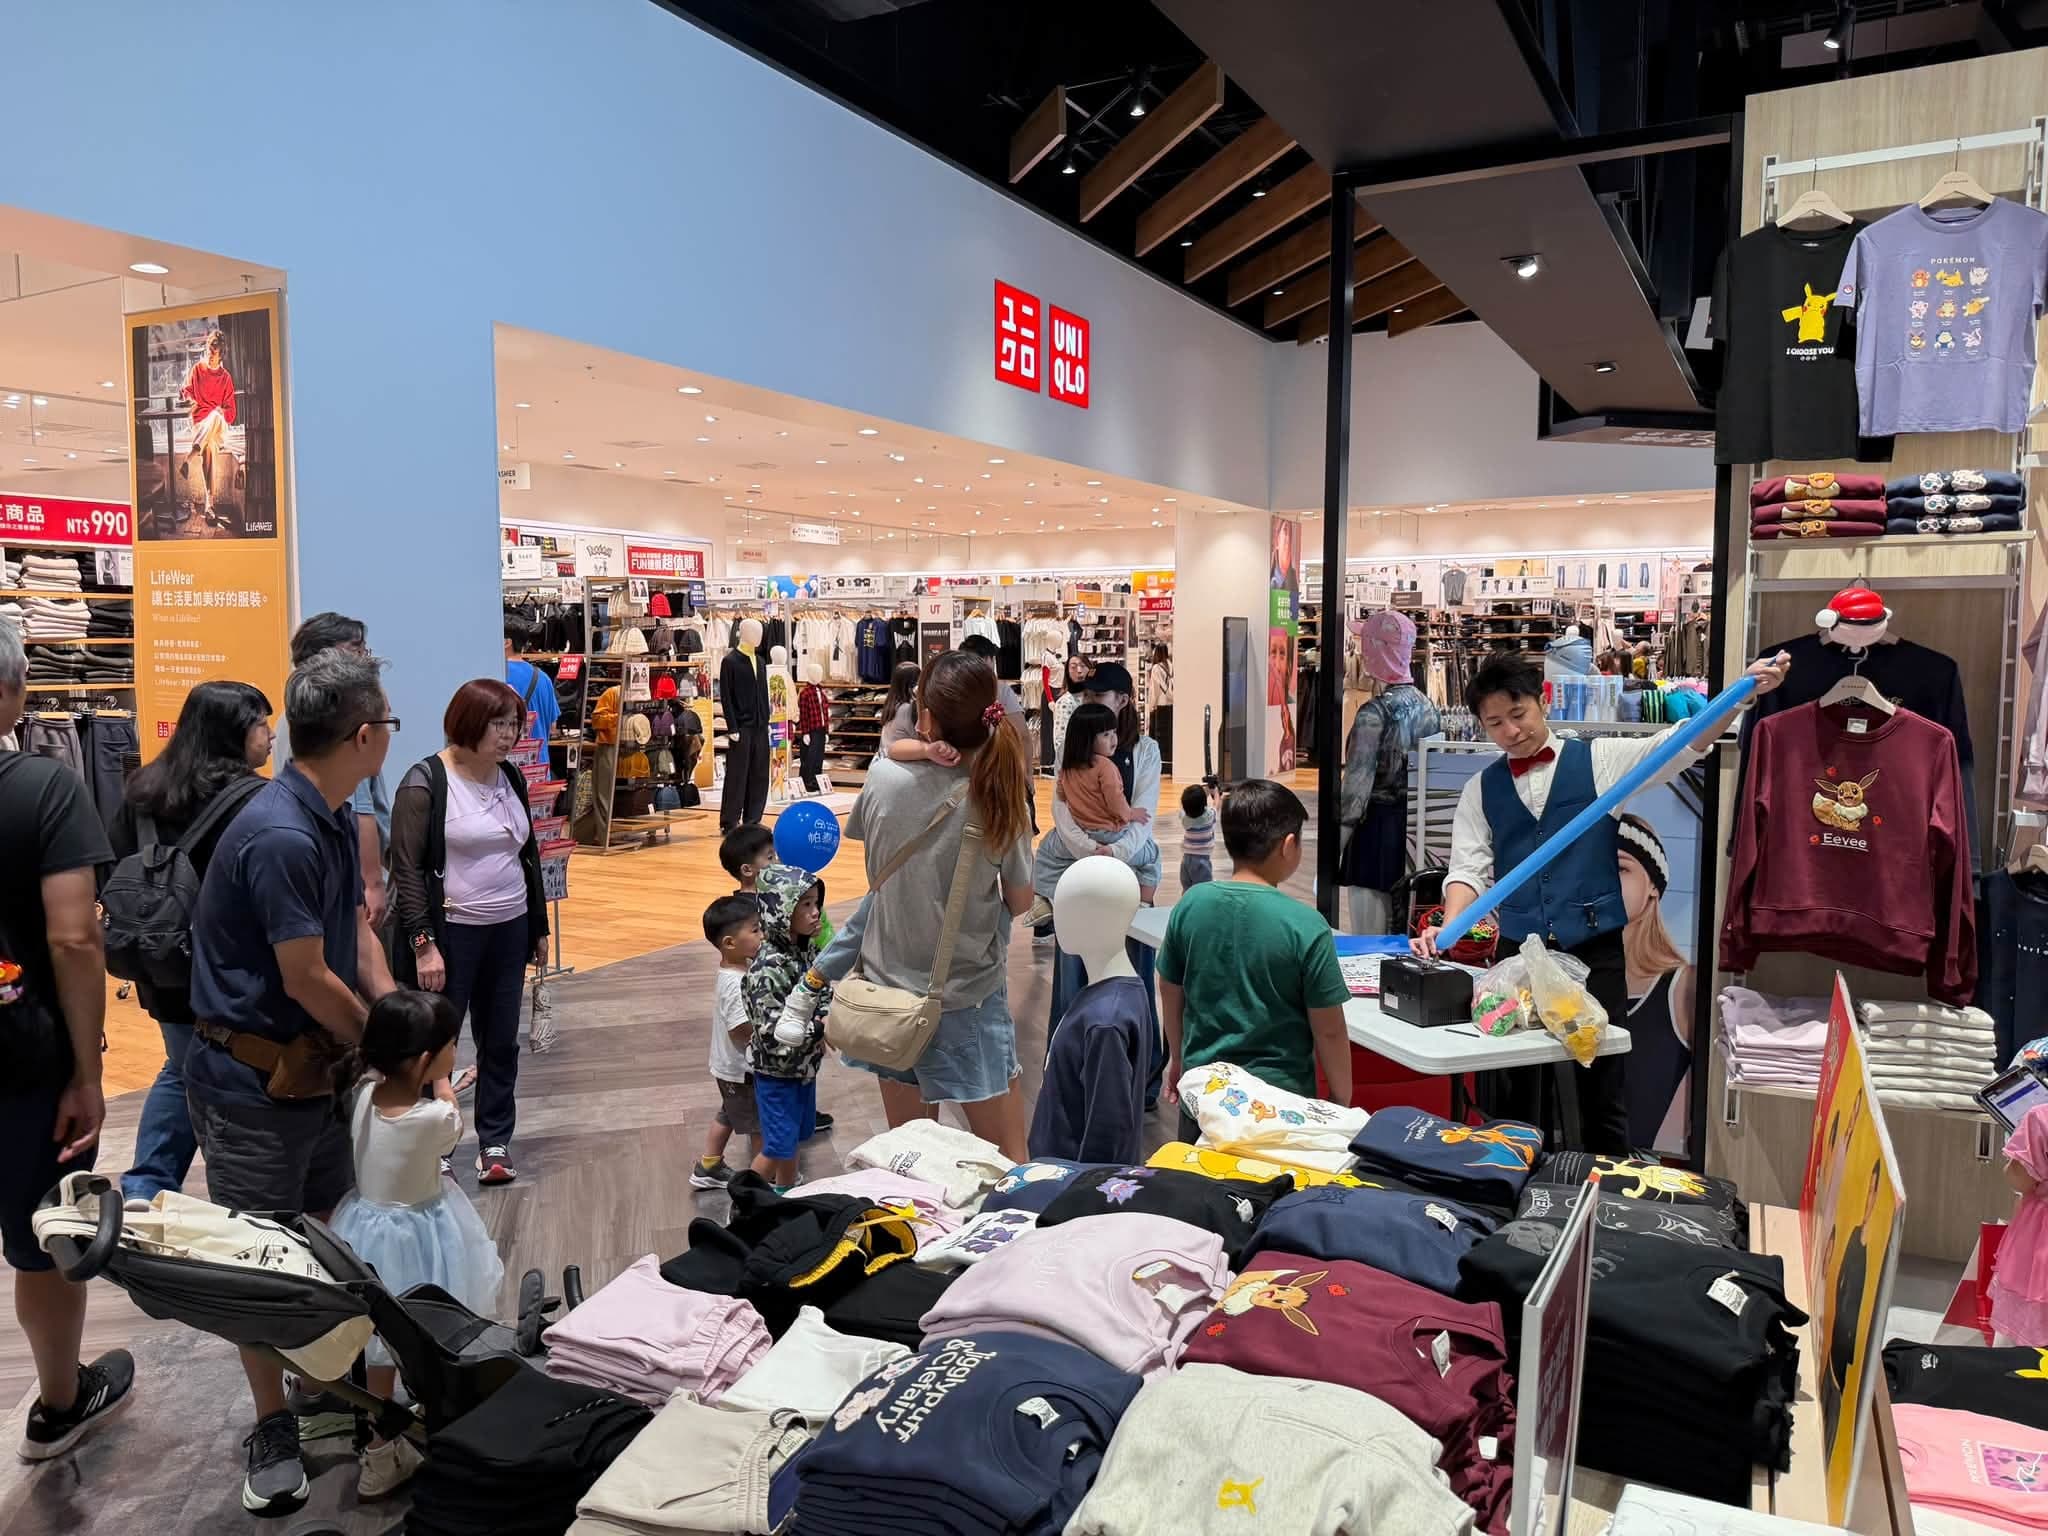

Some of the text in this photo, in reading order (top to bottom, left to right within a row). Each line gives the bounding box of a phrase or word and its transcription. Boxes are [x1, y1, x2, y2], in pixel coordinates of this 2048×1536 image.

[1054, 319, 1083, 360] UNI
[1791, 347, 1818, 356] CHOOSE
[1818, 346, 1835, 355] YOU
[1054, 356, 1086, 395] QLO
[0, 503, 45, 523] 商品
[245, 521, 273, 532] LifeWear
[150, 570, 194, 585] LifeWear
[930, 604, 941, 614] UT
[1823, 833, 1867, 848] Eevee
[896, 1344, 997, 1443] Jigglypuff
